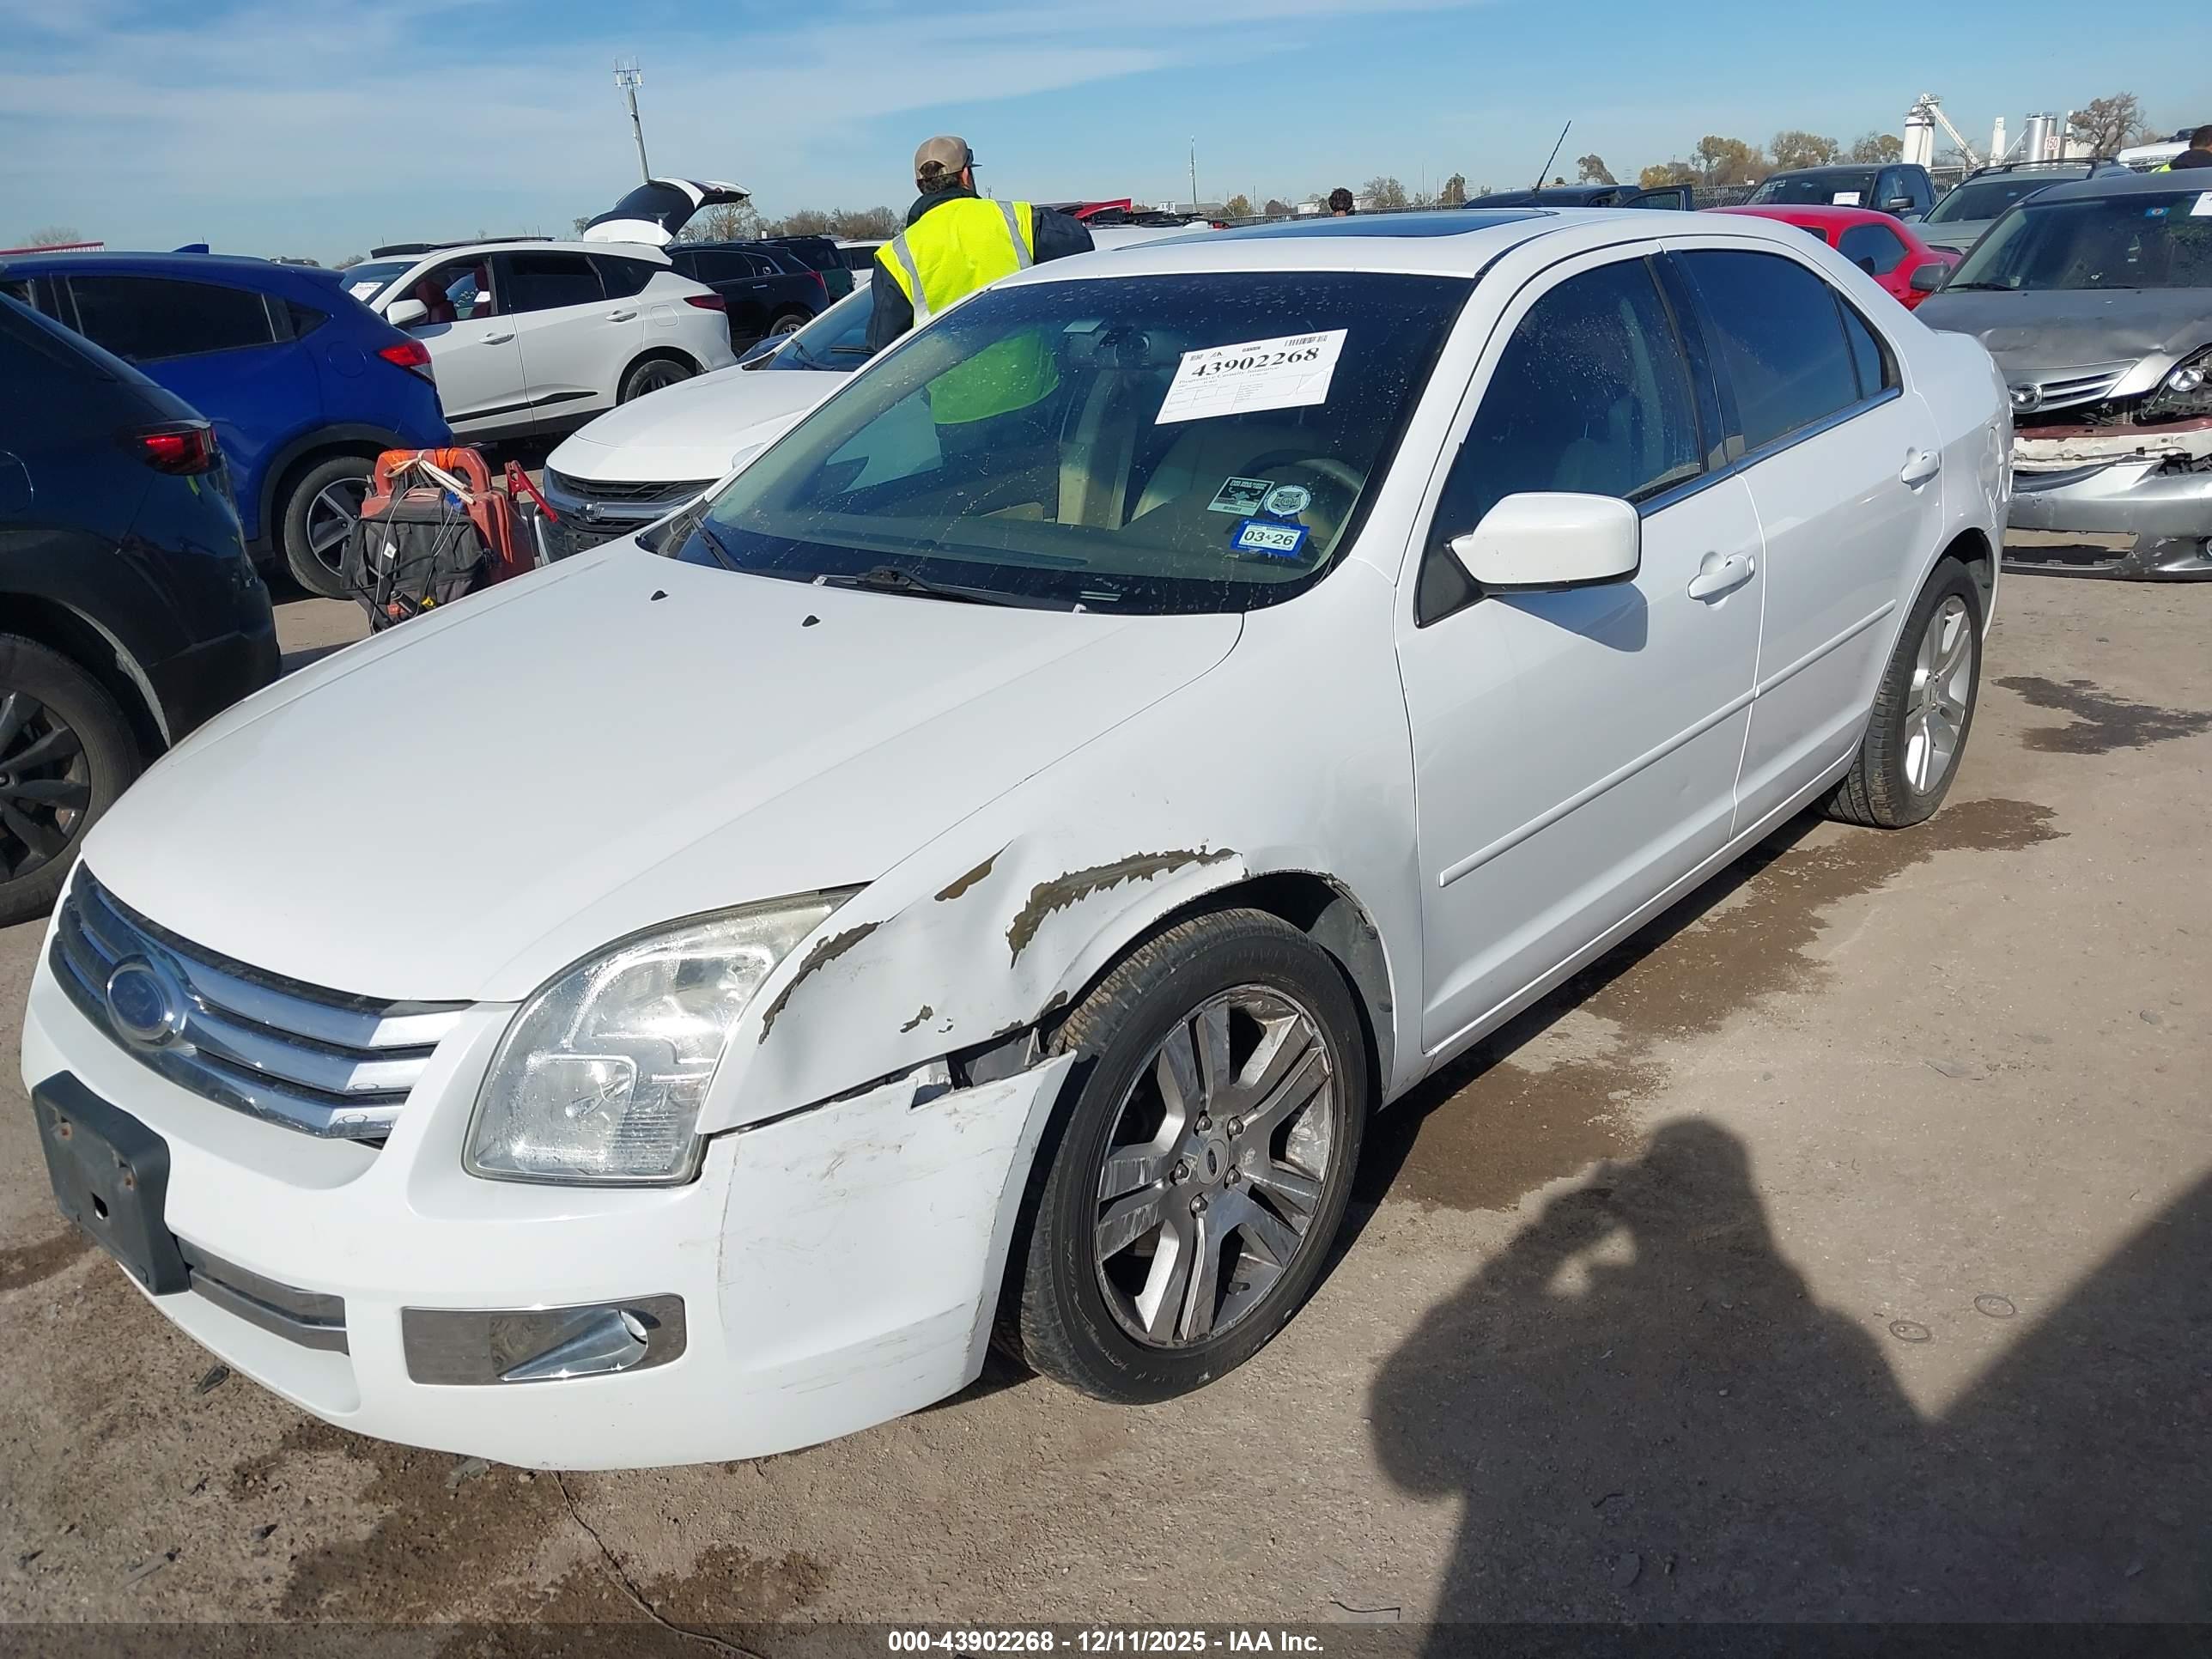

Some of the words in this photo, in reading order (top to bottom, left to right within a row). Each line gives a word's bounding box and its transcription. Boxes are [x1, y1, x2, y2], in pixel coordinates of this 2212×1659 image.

[2046, 137, 2058, 149] 150
[1191, 347, 1320, 377] 43902268
[1243, 530, 1266, 543] 03
[1271, 533, 1295, 546] 26
